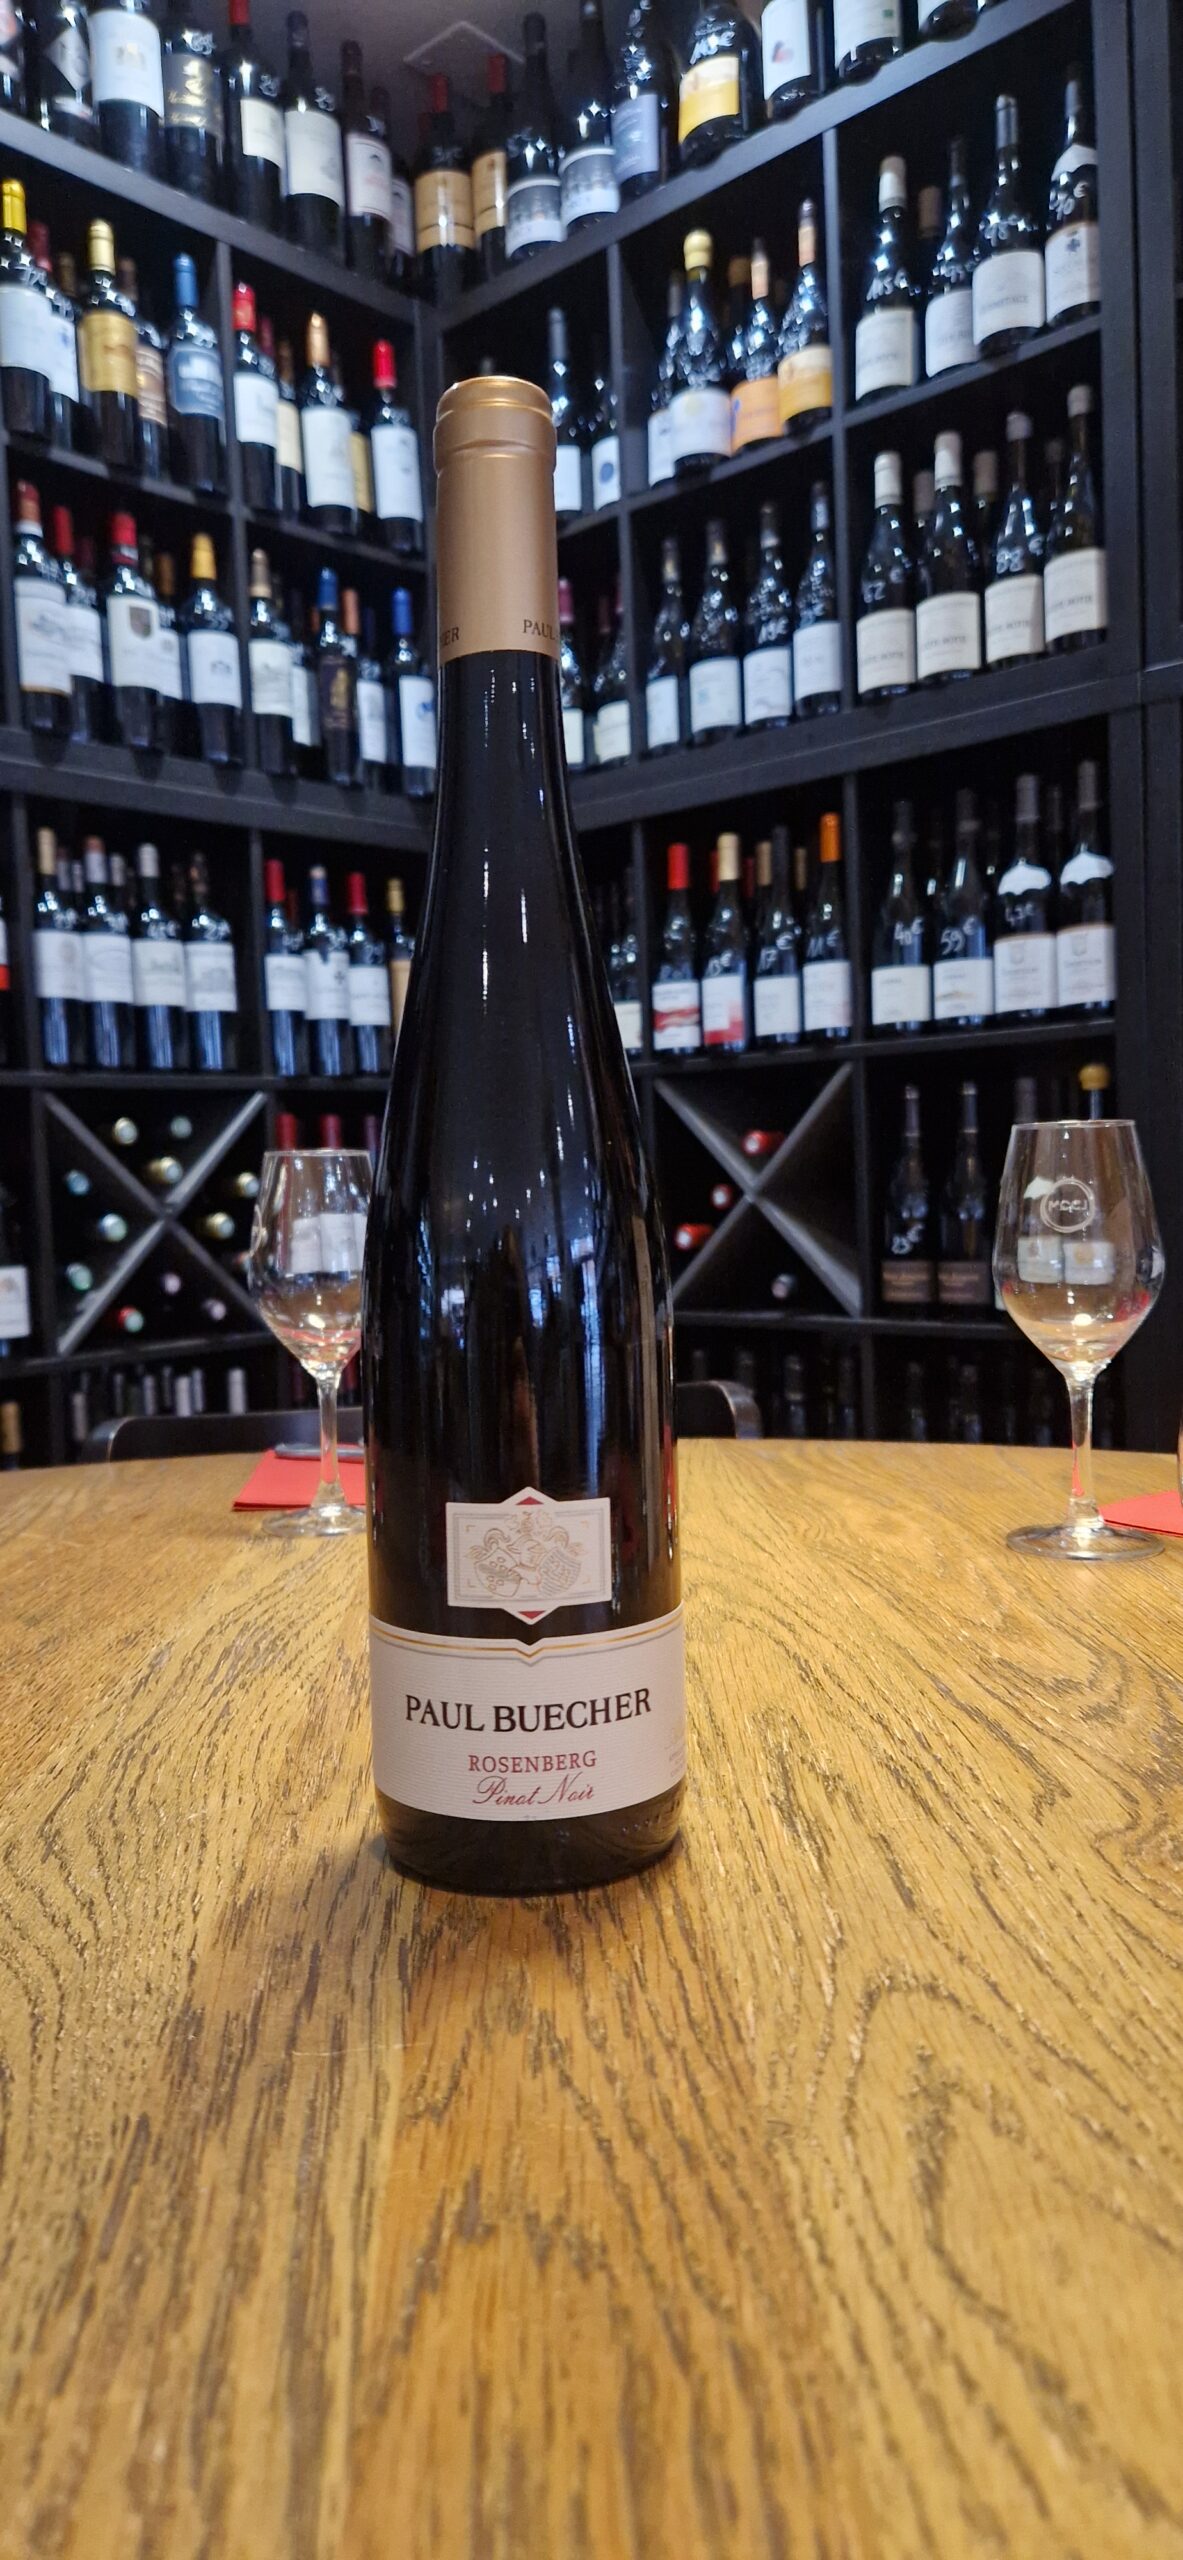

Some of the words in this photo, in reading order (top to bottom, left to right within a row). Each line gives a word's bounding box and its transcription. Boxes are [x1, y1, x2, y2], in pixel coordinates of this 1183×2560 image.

[523, 619, 556, 641] PAUL
[941, 917, 977, 956] 59€
[405, 1694, 485, 1731] PAUL
[492, 1688, 651, 1733] BUECHER
[467, 1750, 598, 1773] ROSENBERG
[472, 1775, 541, 1806] Pinot
[537, 1772, 594, 1804] Noir
